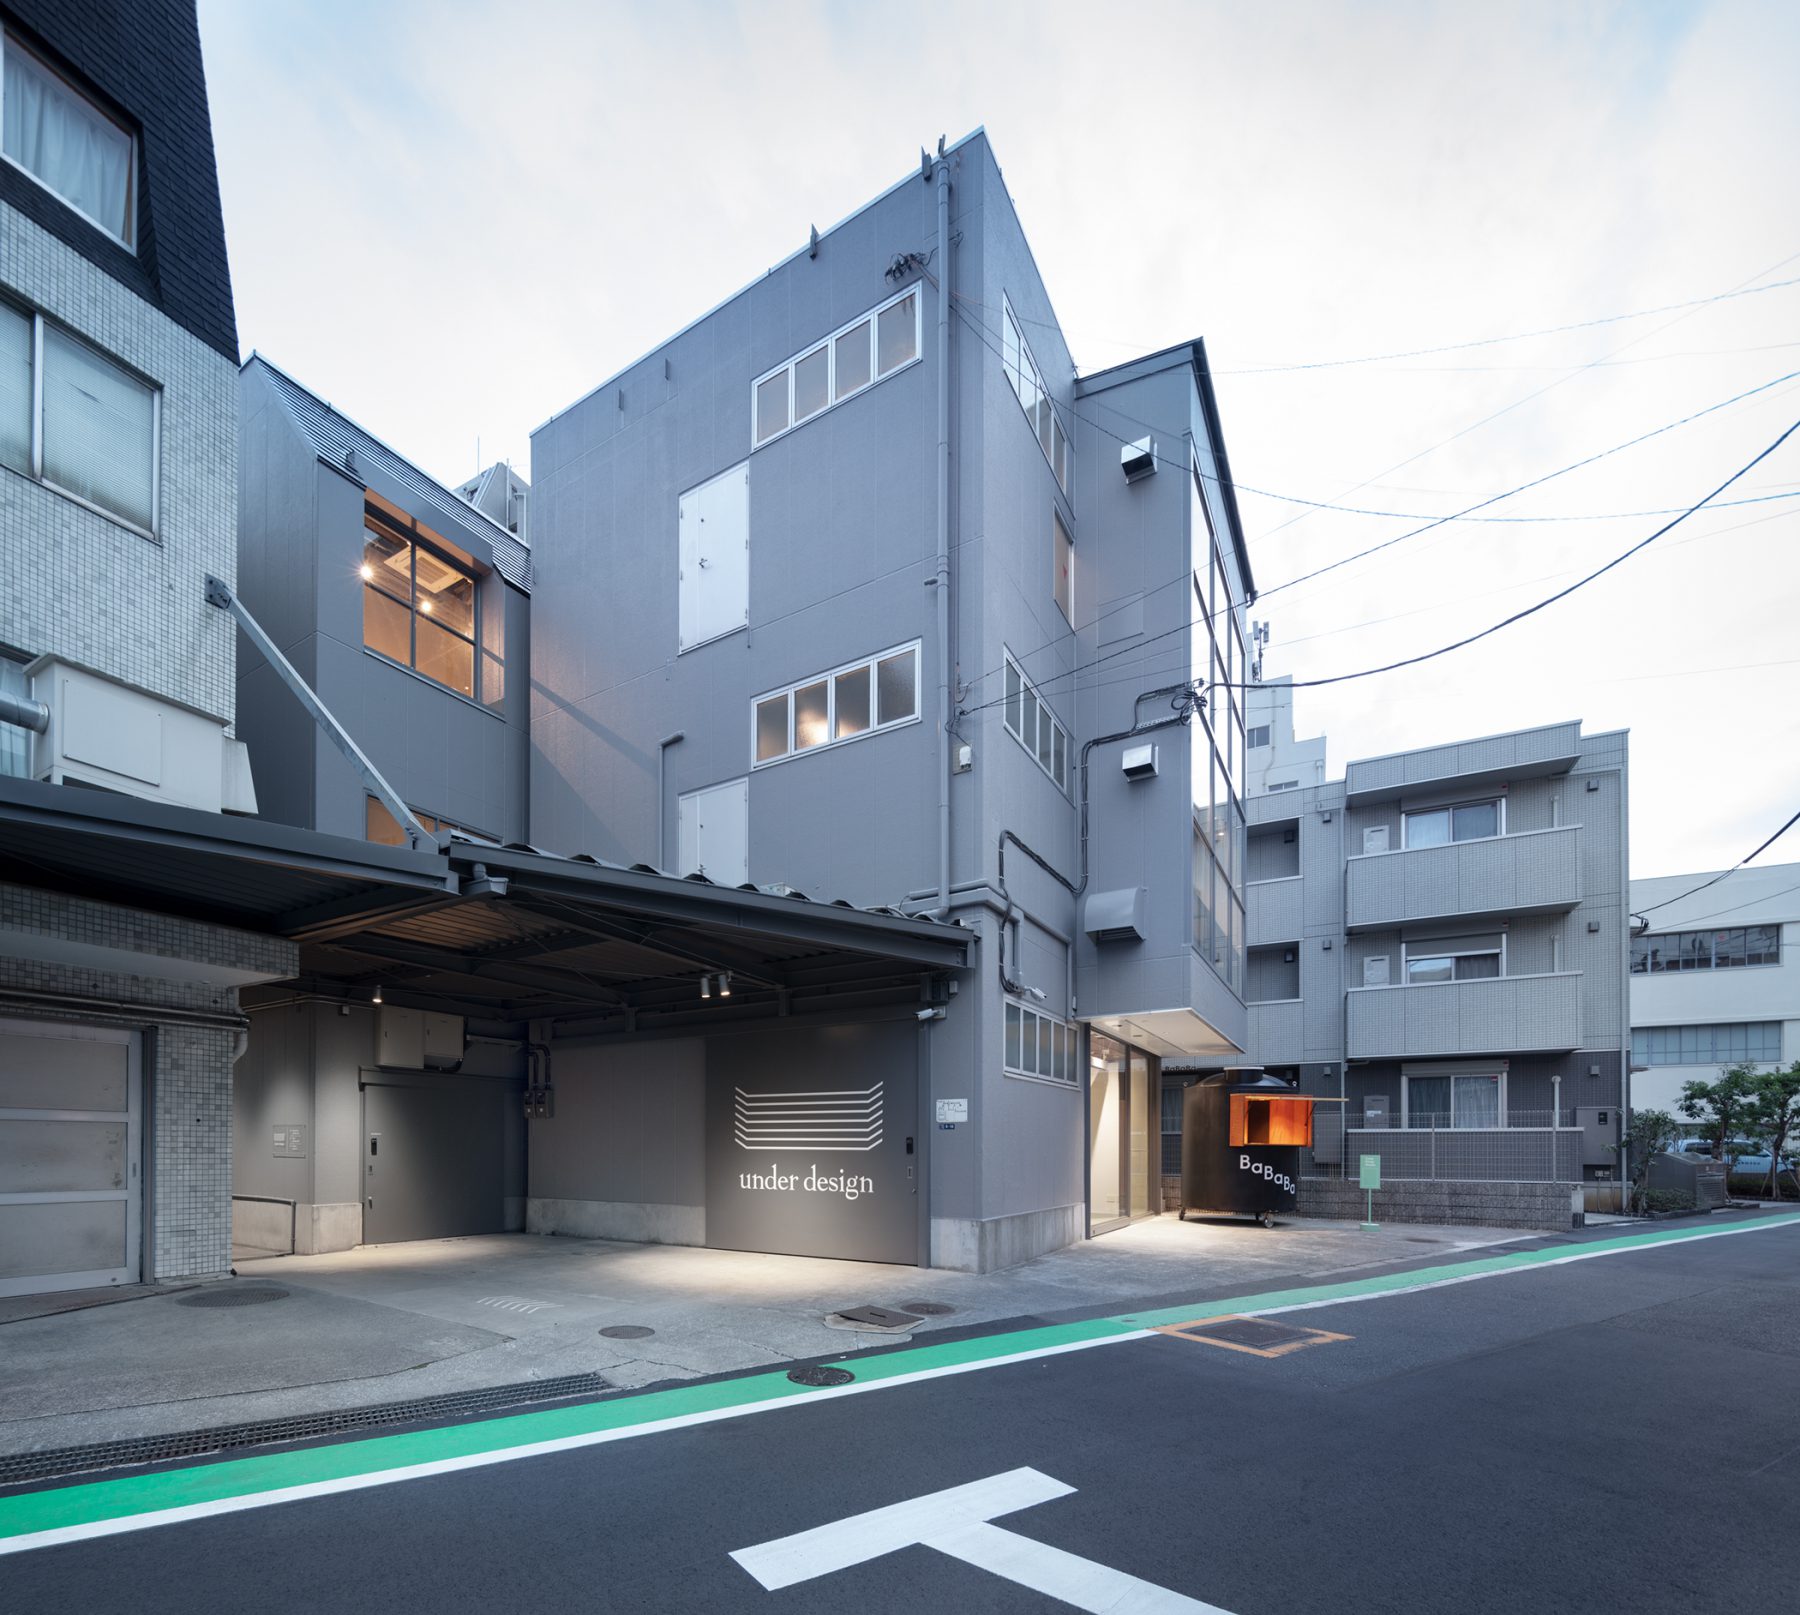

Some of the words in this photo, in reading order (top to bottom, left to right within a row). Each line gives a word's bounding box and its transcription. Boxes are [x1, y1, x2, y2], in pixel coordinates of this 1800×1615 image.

[739, 1163, 799, 1190] under
[803, 1163, 874, 1200] design
[1239, 1154, 1295, 1194] BaBaBa
